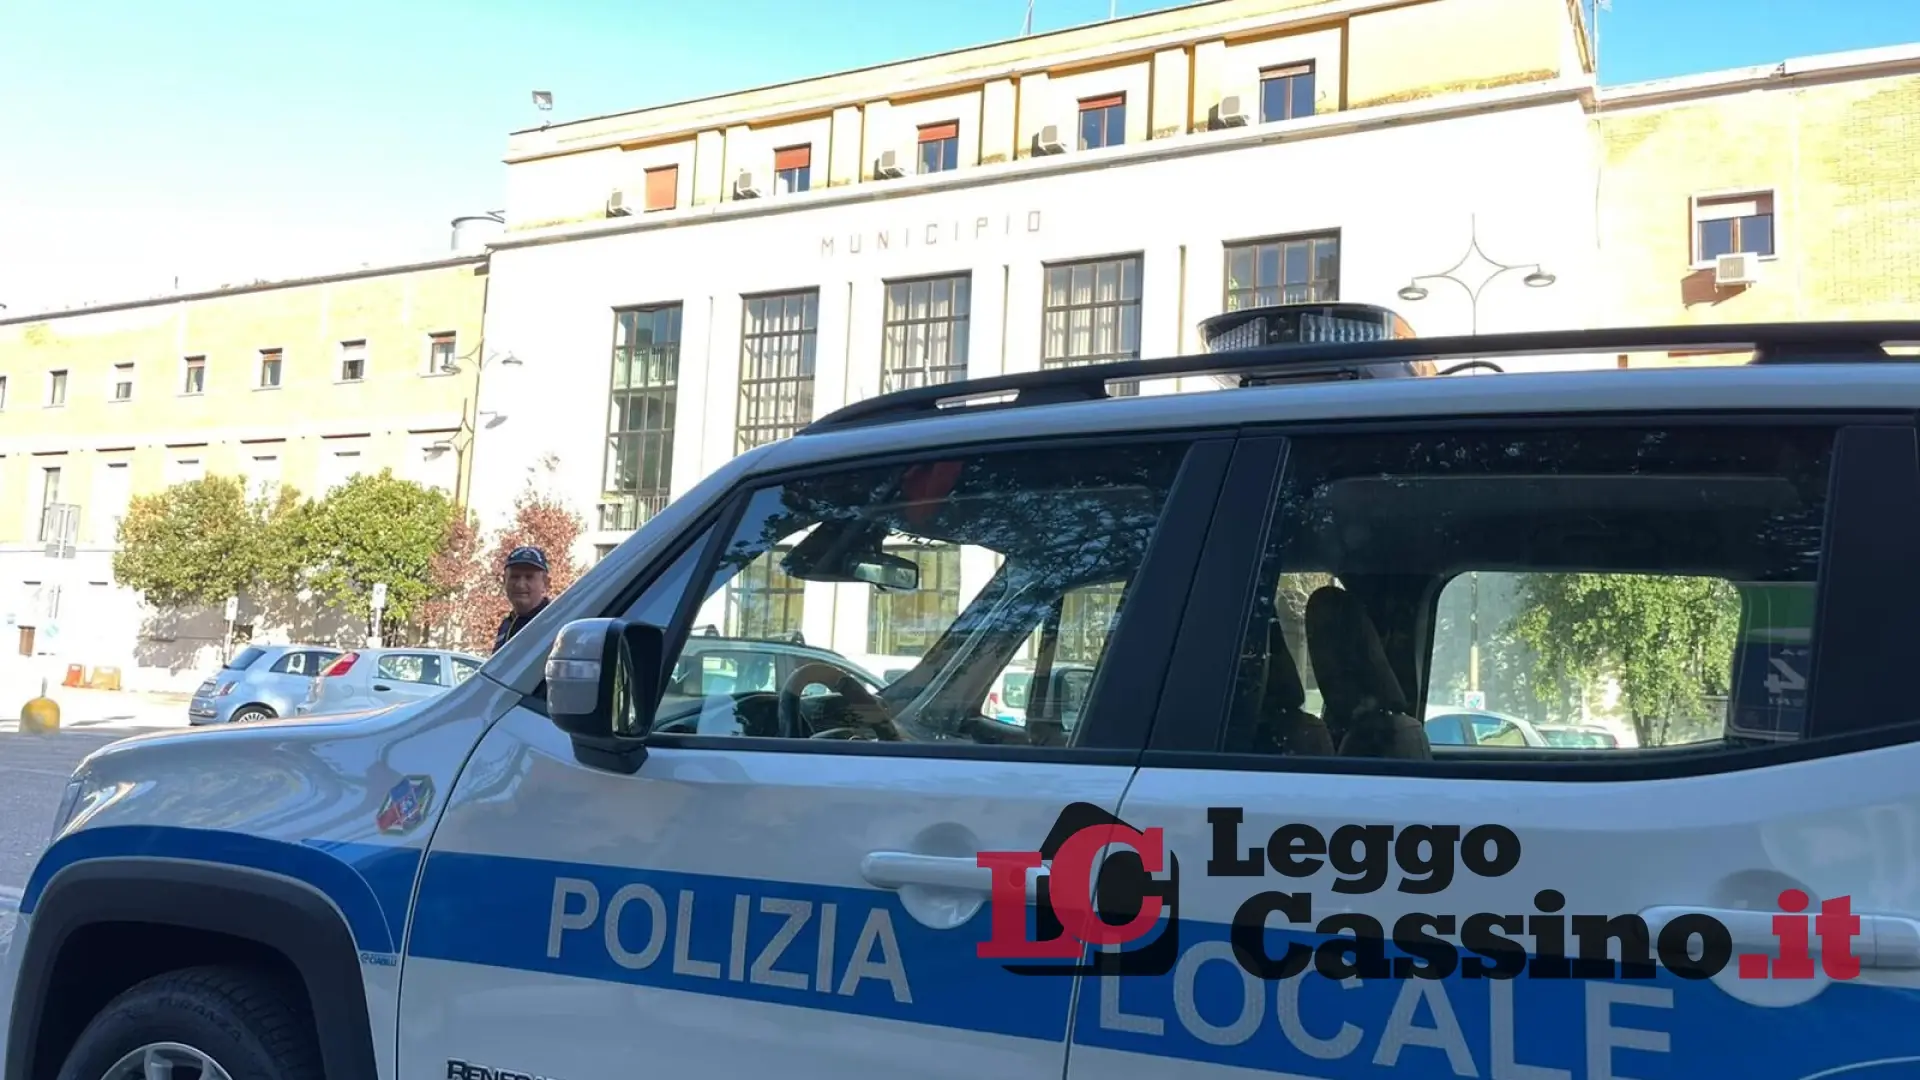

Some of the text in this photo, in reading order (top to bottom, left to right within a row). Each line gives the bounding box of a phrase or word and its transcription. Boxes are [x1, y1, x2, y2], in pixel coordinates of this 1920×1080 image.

[820, 210, 1042, 257] MUNICIPIO
[547, 877, 1675, 1080] POLIZIA LOCALE
